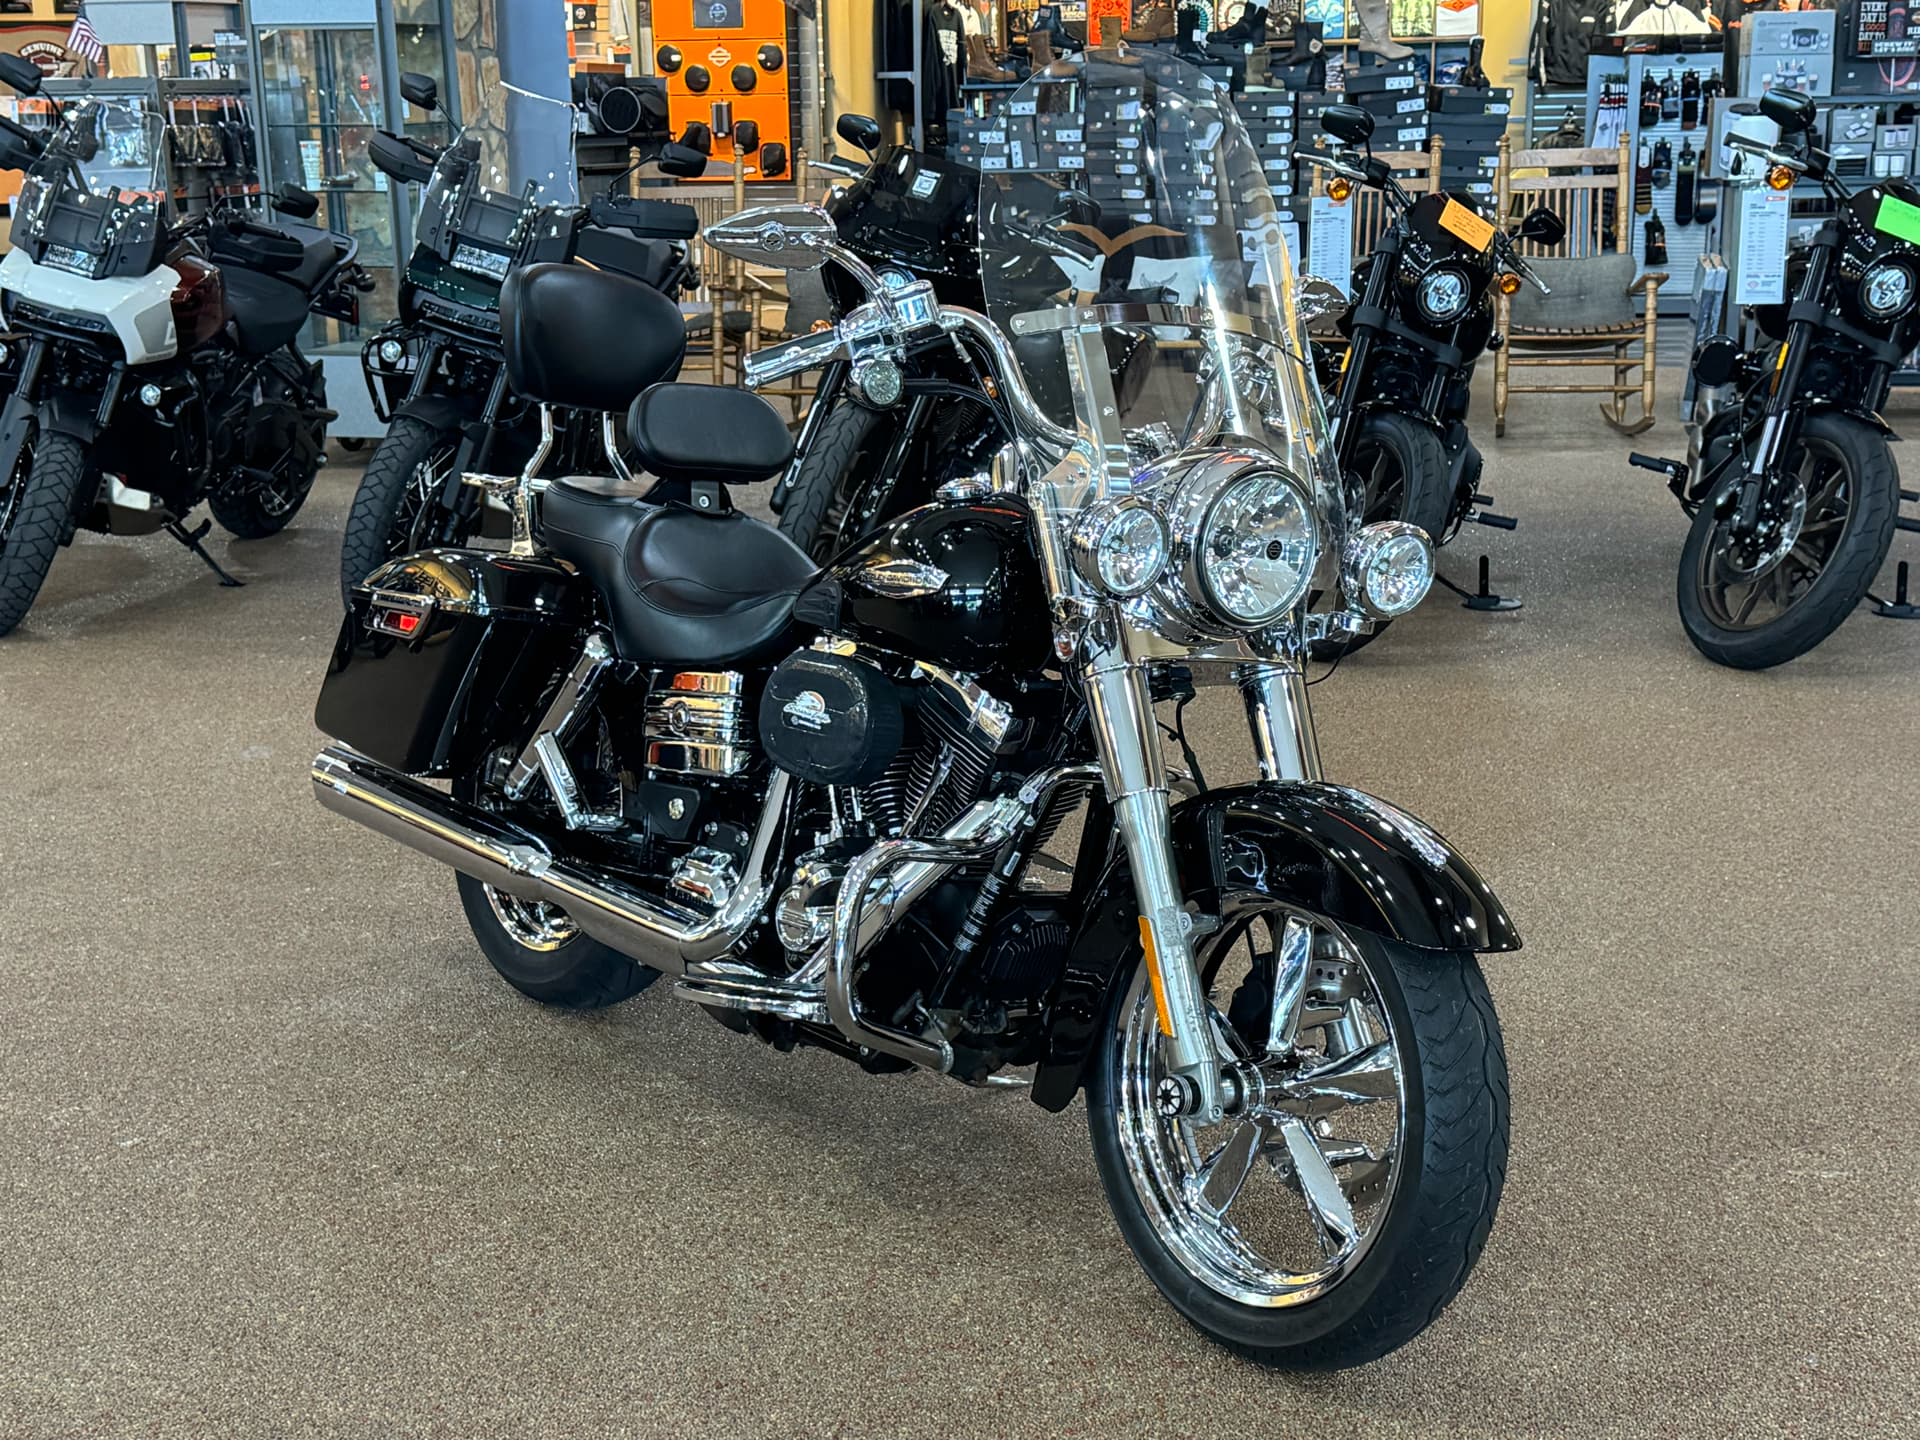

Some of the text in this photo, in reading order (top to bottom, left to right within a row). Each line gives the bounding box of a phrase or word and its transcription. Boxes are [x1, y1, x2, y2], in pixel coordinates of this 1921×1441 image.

[1861, 2, 1888, 11] EVERY
[1860, 13, 1887, 22] DAY IS
[1859, 23, 1886, 31] A GOOD
[1859, 32, 1873, 41] DAY
[21, 43, 65, 57] GENUINE
